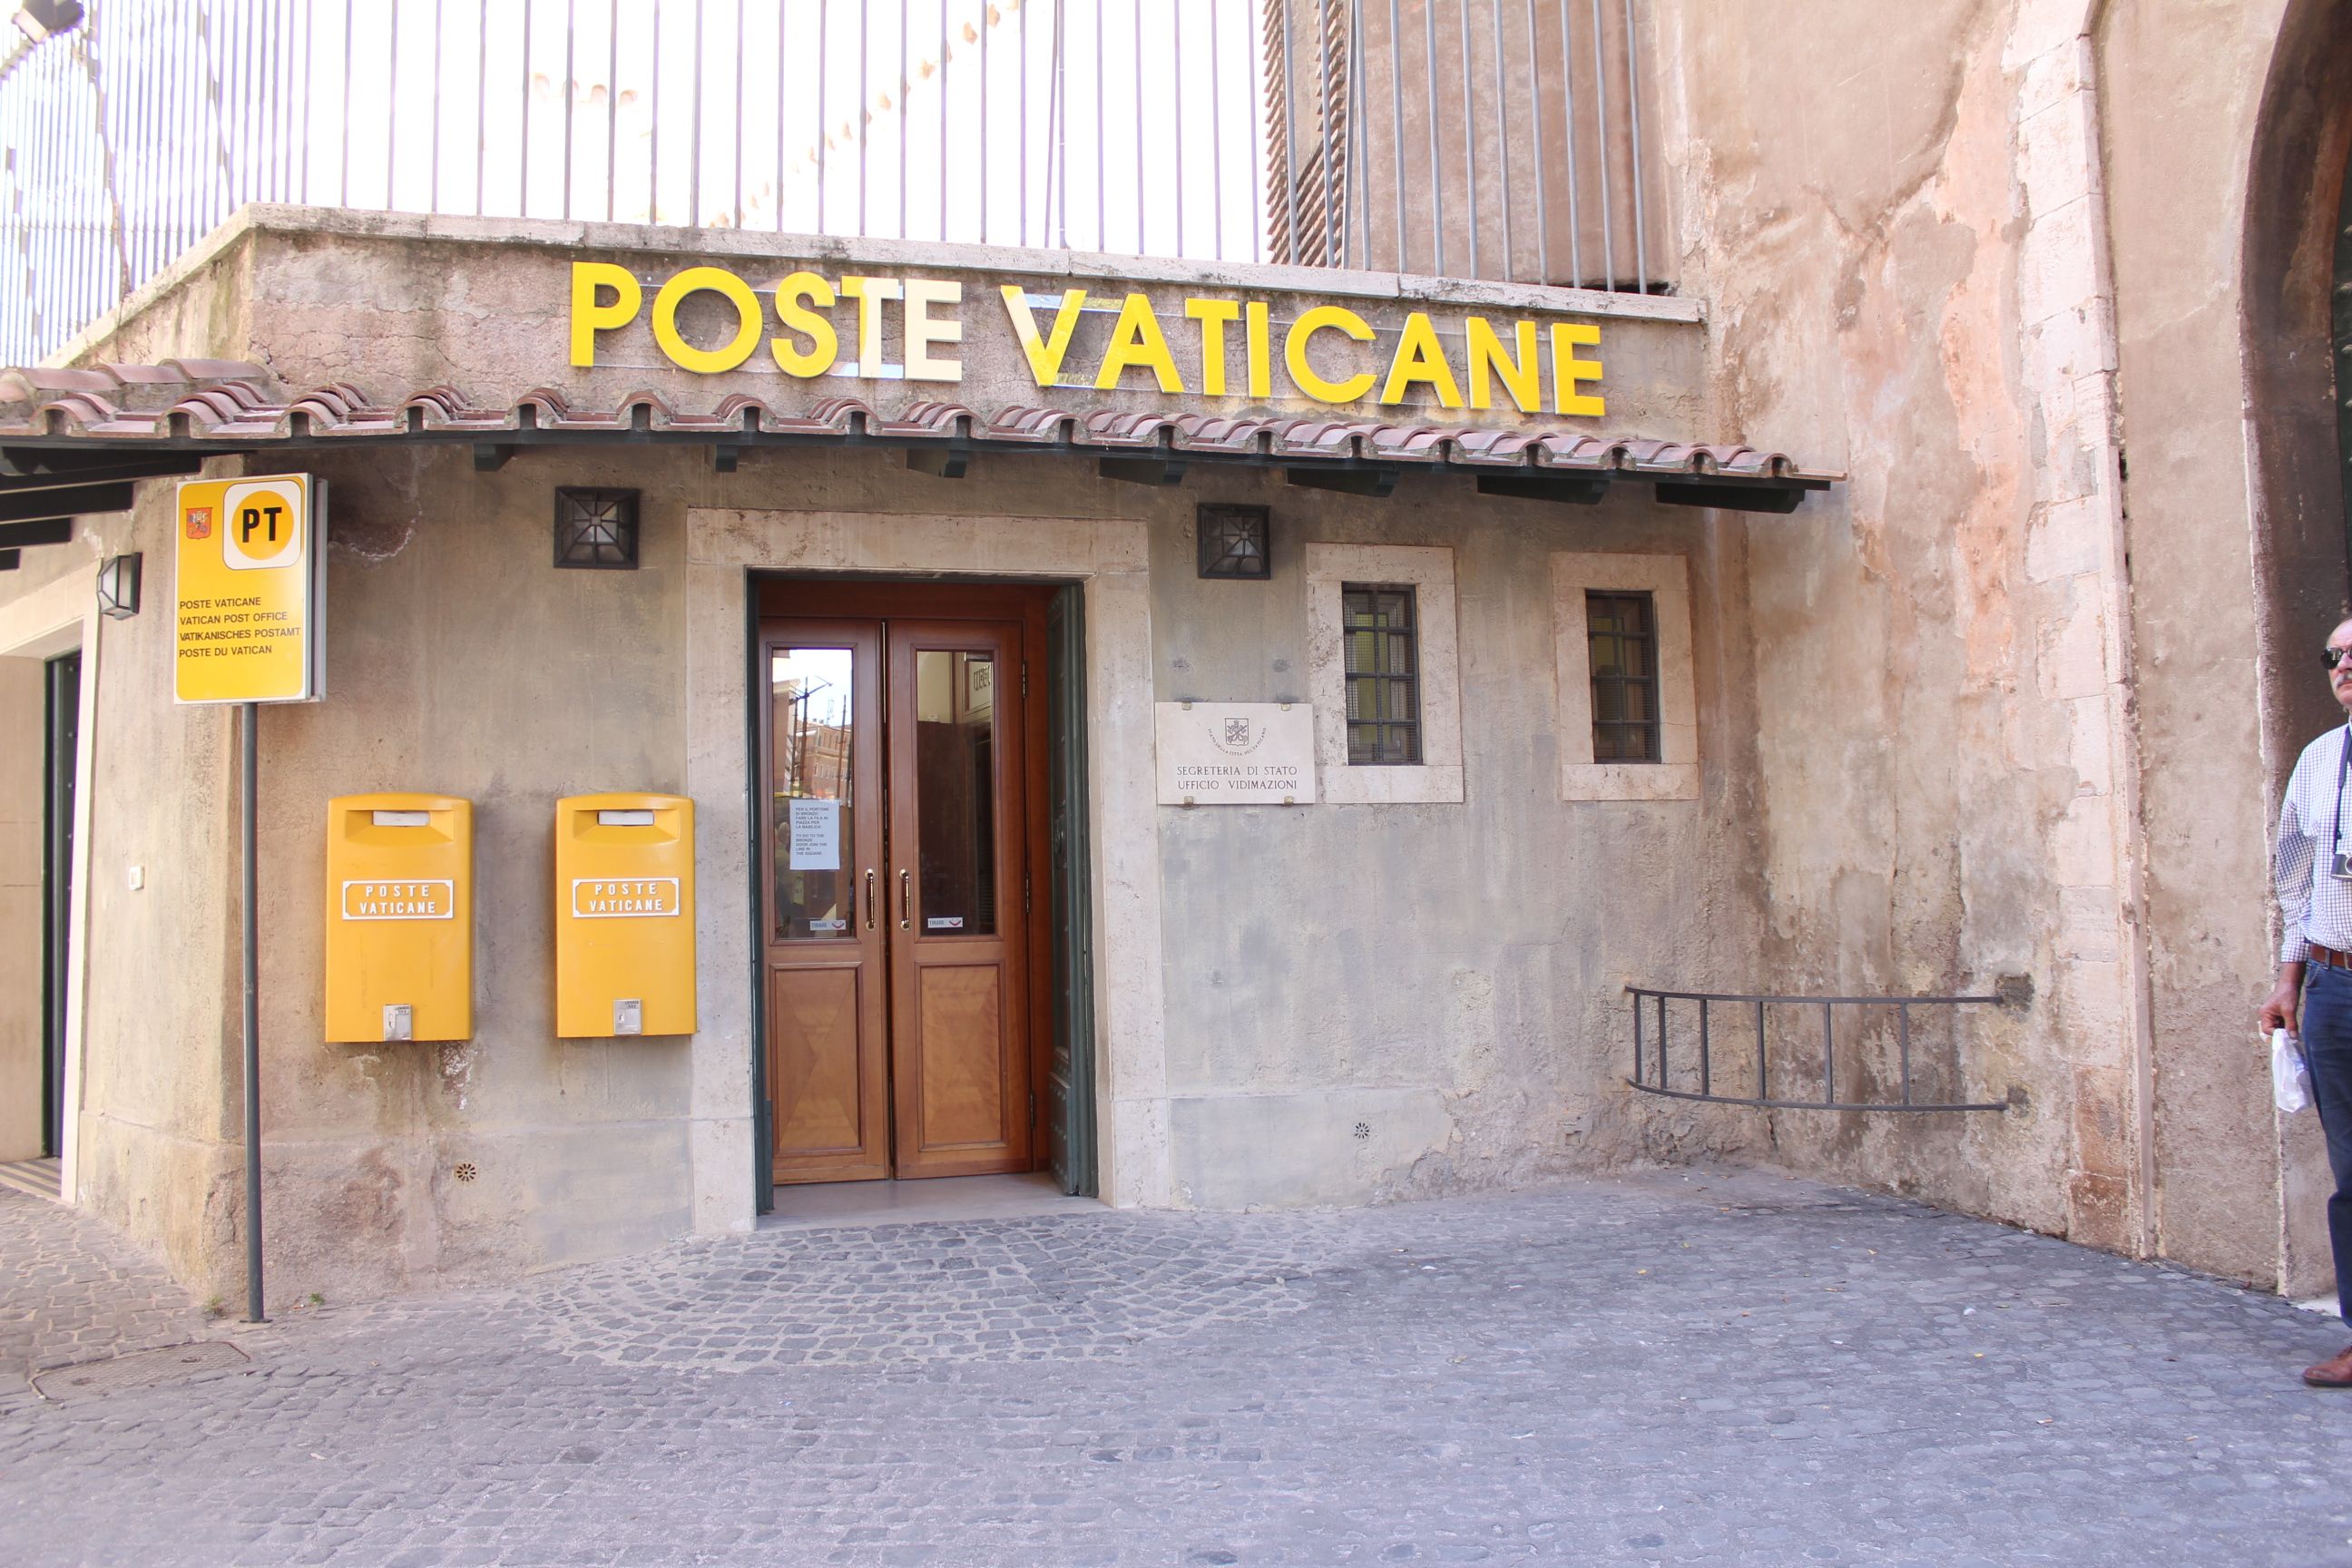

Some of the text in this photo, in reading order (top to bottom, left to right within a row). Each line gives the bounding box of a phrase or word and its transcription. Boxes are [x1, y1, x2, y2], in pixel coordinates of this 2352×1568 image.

[570, 260, 1605, 417] POSTE VATICANE
[242, 506, 282, 544] PT
[180, 596, 261, 610] POSTE VATICANE
[180, 611, 289, 625] VATICAN POST OFFICE
[180, 626, 301, 642] VATIKANISCHES POSTAMT
[179, 644, 272, 658] POSTE DU VATICAN
[1177, 766, 1298, 776] SEGRETERIA DI STATO
[1178, 779, 1298, 790] UFFICIO VIDIMAZIONI
[365, 885, 430, 897] POSTE
[595, 883, 657, 896] POSTE
[359, 901, 436, 915] VATICANE
[589, 899, 662, 912] VATICANE
